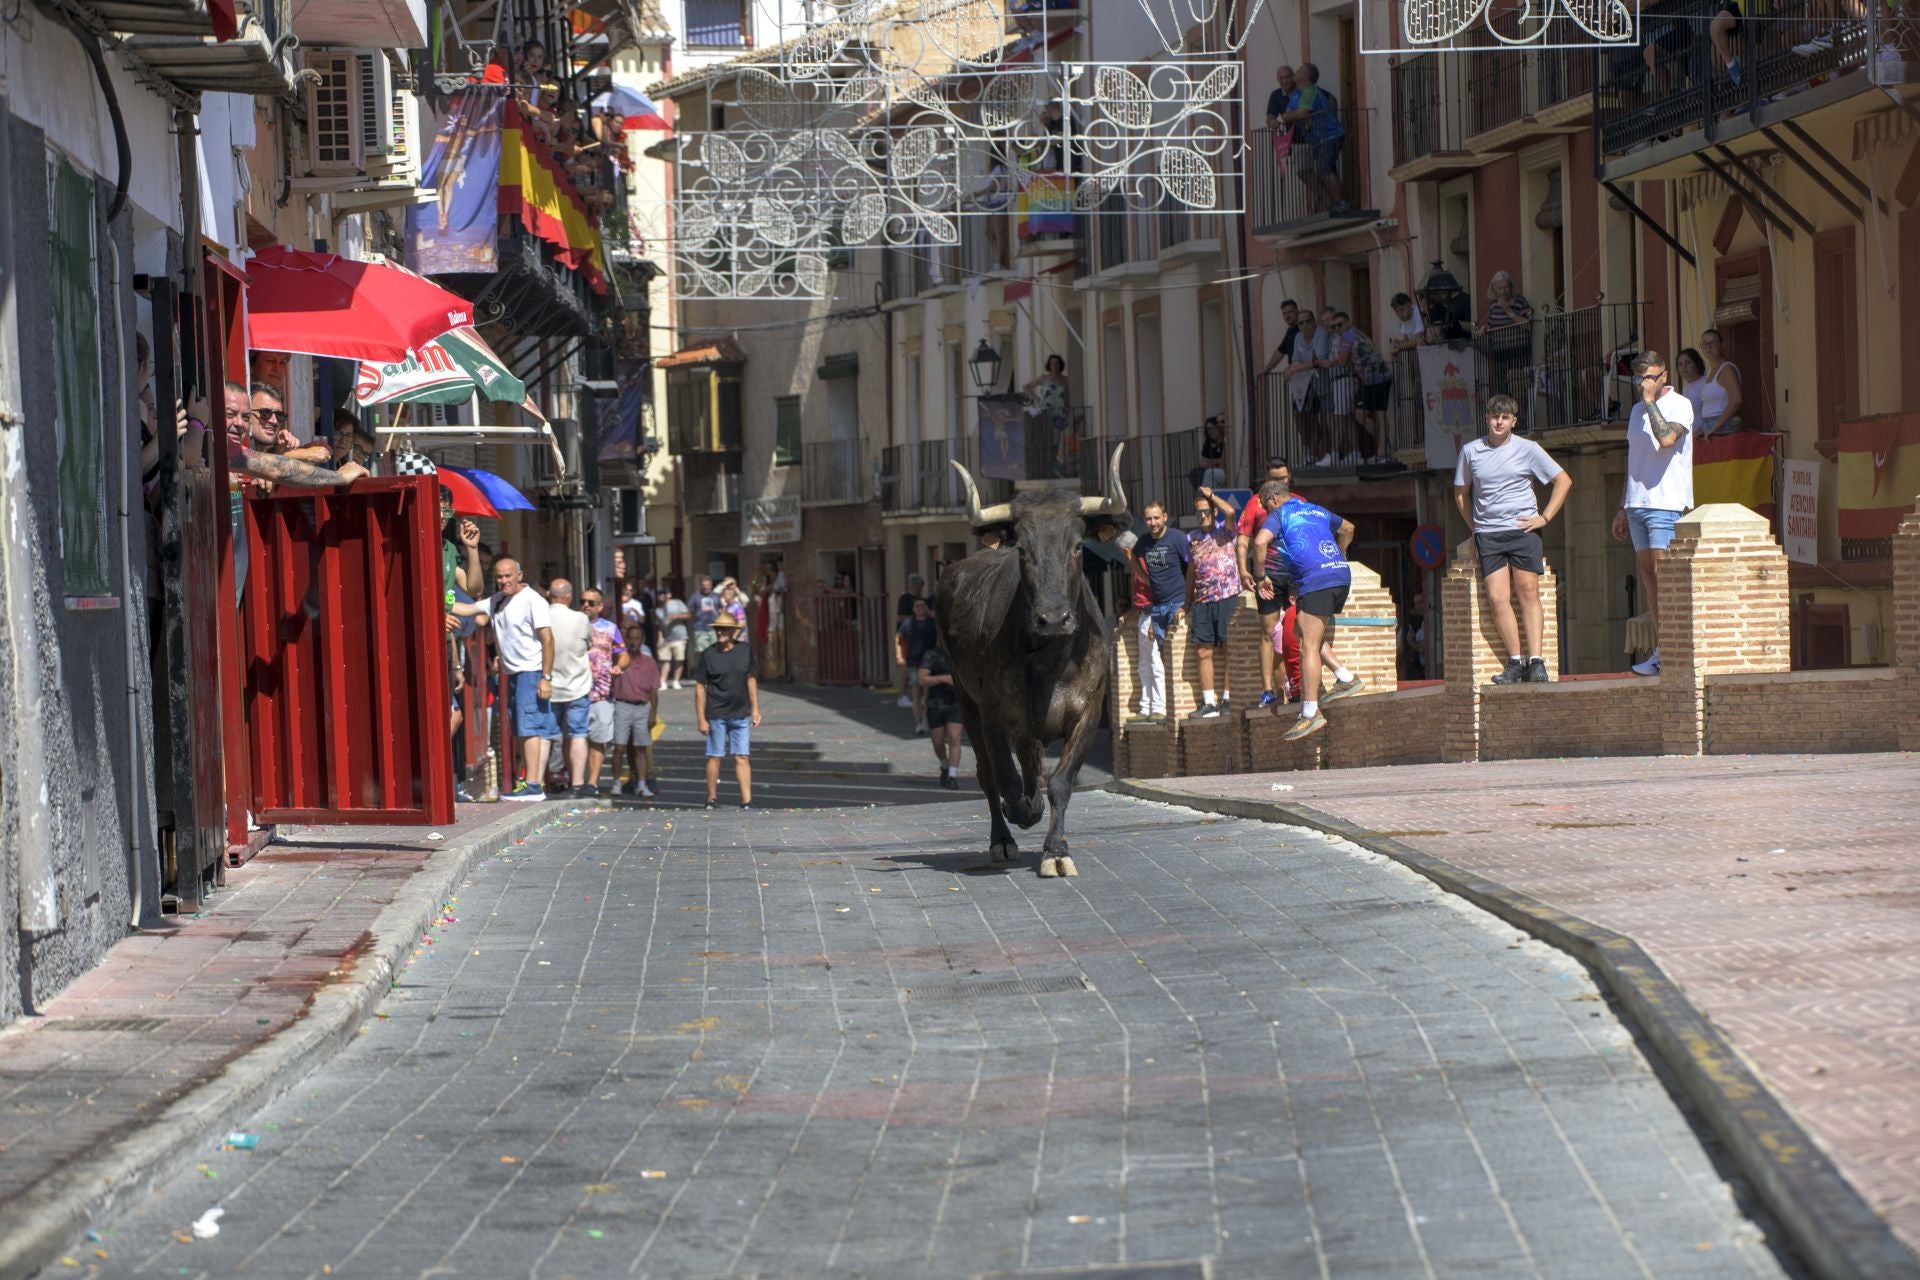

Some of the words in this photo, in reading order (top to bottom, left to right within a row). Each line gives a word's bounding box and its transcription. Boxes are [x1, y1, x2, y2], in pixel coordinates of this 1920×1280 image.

[1792, 470, 1806, 485] PUNTO
[1790, 488, 1816, 514] ATENCIÓN
[1788, 514, 1817, 540] SANITARIA
